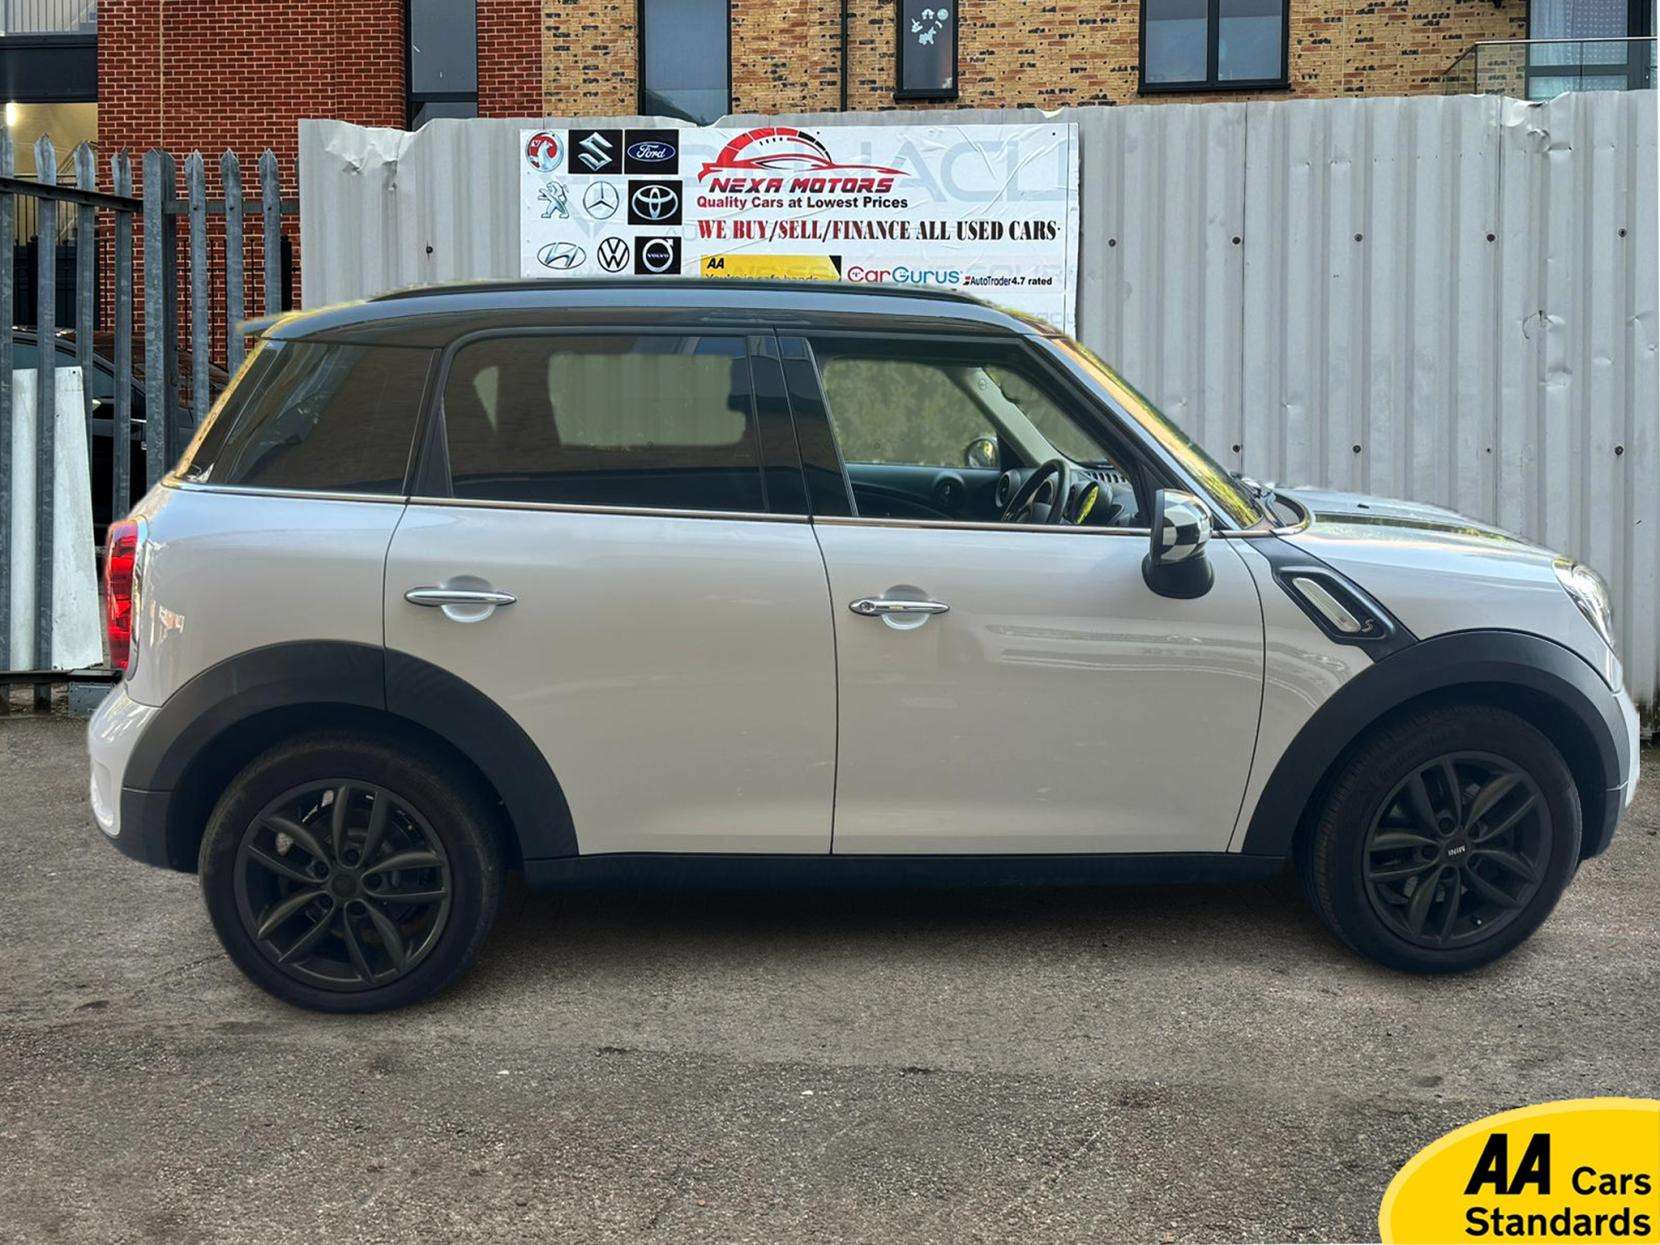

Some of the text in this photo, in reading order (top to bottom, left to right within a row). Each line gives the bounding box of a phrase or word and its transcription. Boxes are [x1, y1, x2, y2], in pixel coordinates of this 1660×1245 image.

[636, 143, 666, 159] Ford
[709, 178, 895, 193] NEXA MOTORS
[697, 195, 908, 210] Quality Cars at Lowest Prices
[697, 219, 727, 240] WE
[917, 220, 951, 240] ALL
[957, 219, 1003, 240] USED
[1009, 219, 1057, 240] CARS
[707, 257, 725, 269] AA
[847, 265, 960, 284] CarGurus
[1028, 275, 1053, 286] rated
